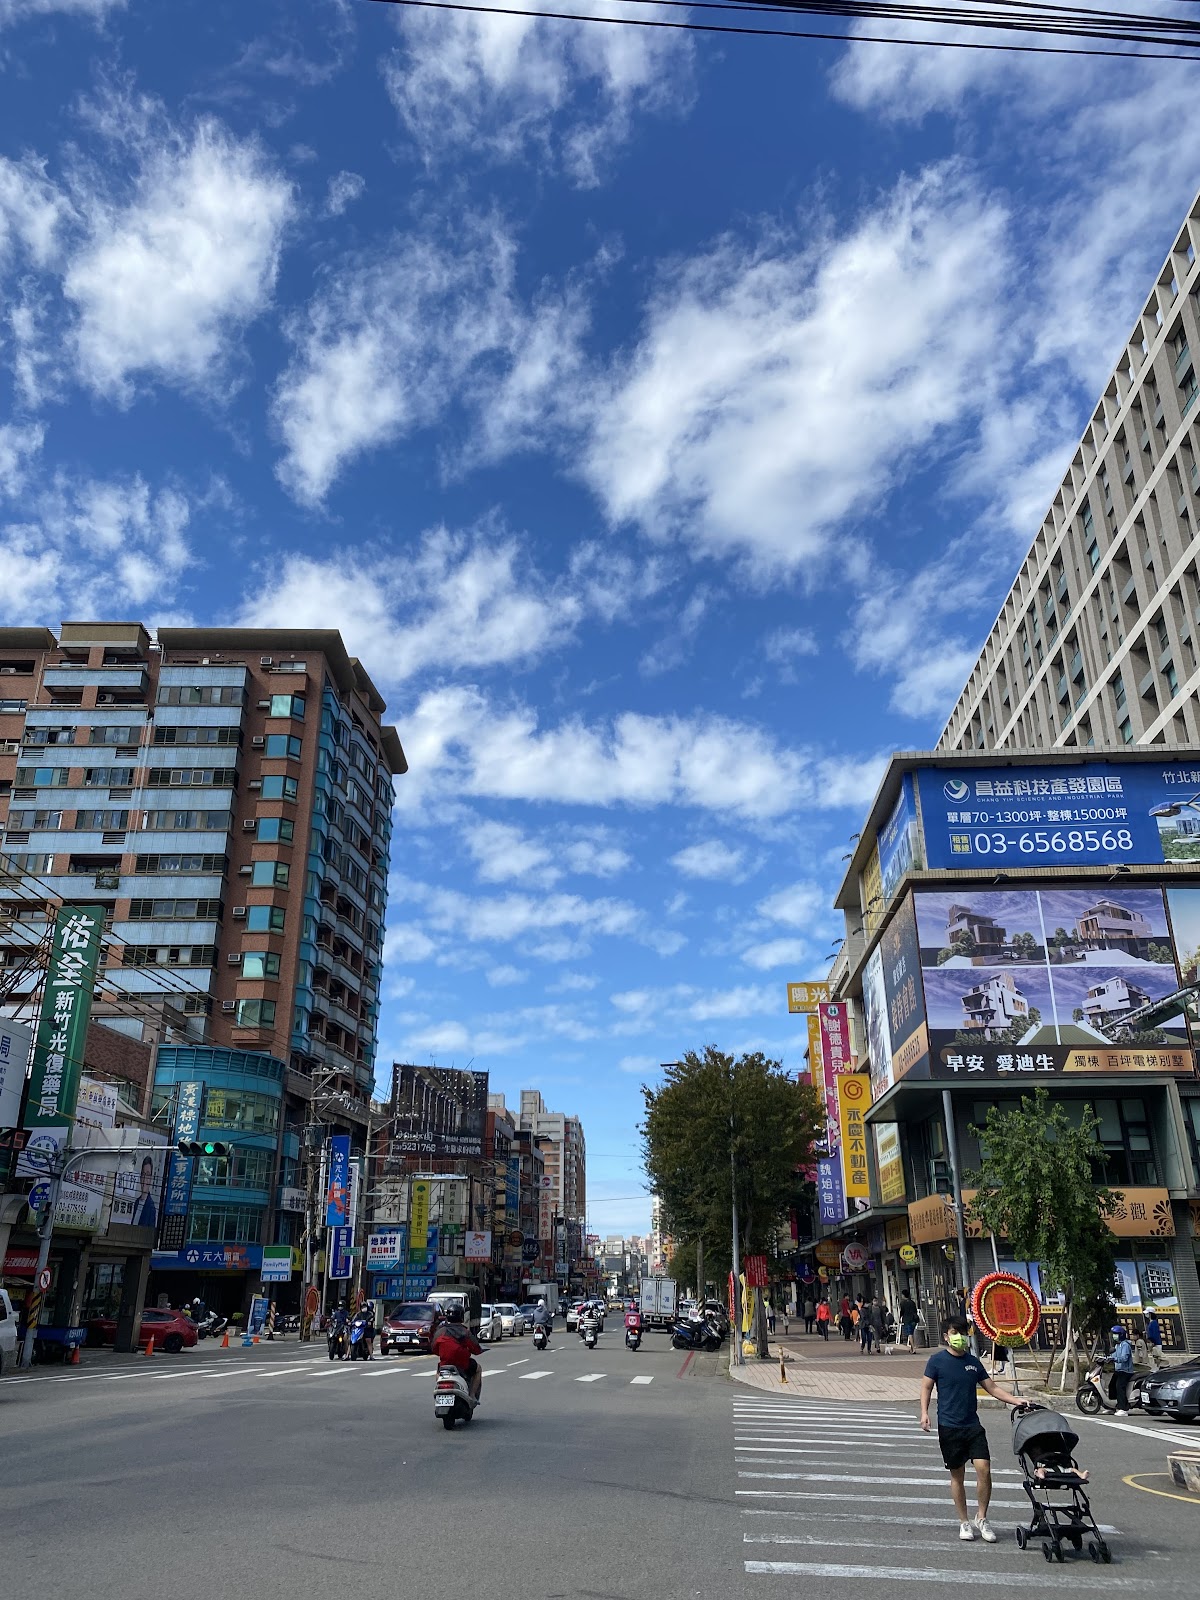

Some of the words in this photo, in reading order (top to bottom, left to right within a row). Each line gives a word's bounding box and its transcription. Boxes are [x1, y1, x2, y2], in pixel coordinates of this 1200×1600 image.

[975, 776, 1123, 797] 昌益科技產發園區
[974, 829, 1134, 854] 03-6568568
[52, 914, 95, 986] 佑全
[791, 986, 826, 1003] 陽光
[37, 990, 75, 1118] 新竹光復藥局
[946, 1054, 985, 1072] 早安
[996, 1053, 1055, 1072] 愛迪生
[1074, 1055, 1100, 1067] 獨棟
[1107, 1054, 1185, 1068] 百坪電梯別墅
[847, 1108, 867, 1185] 永慶不動產
[820, 1163, 835, 1219] 魏姐包心
[371, 1236, 397, 1246] 地球村
